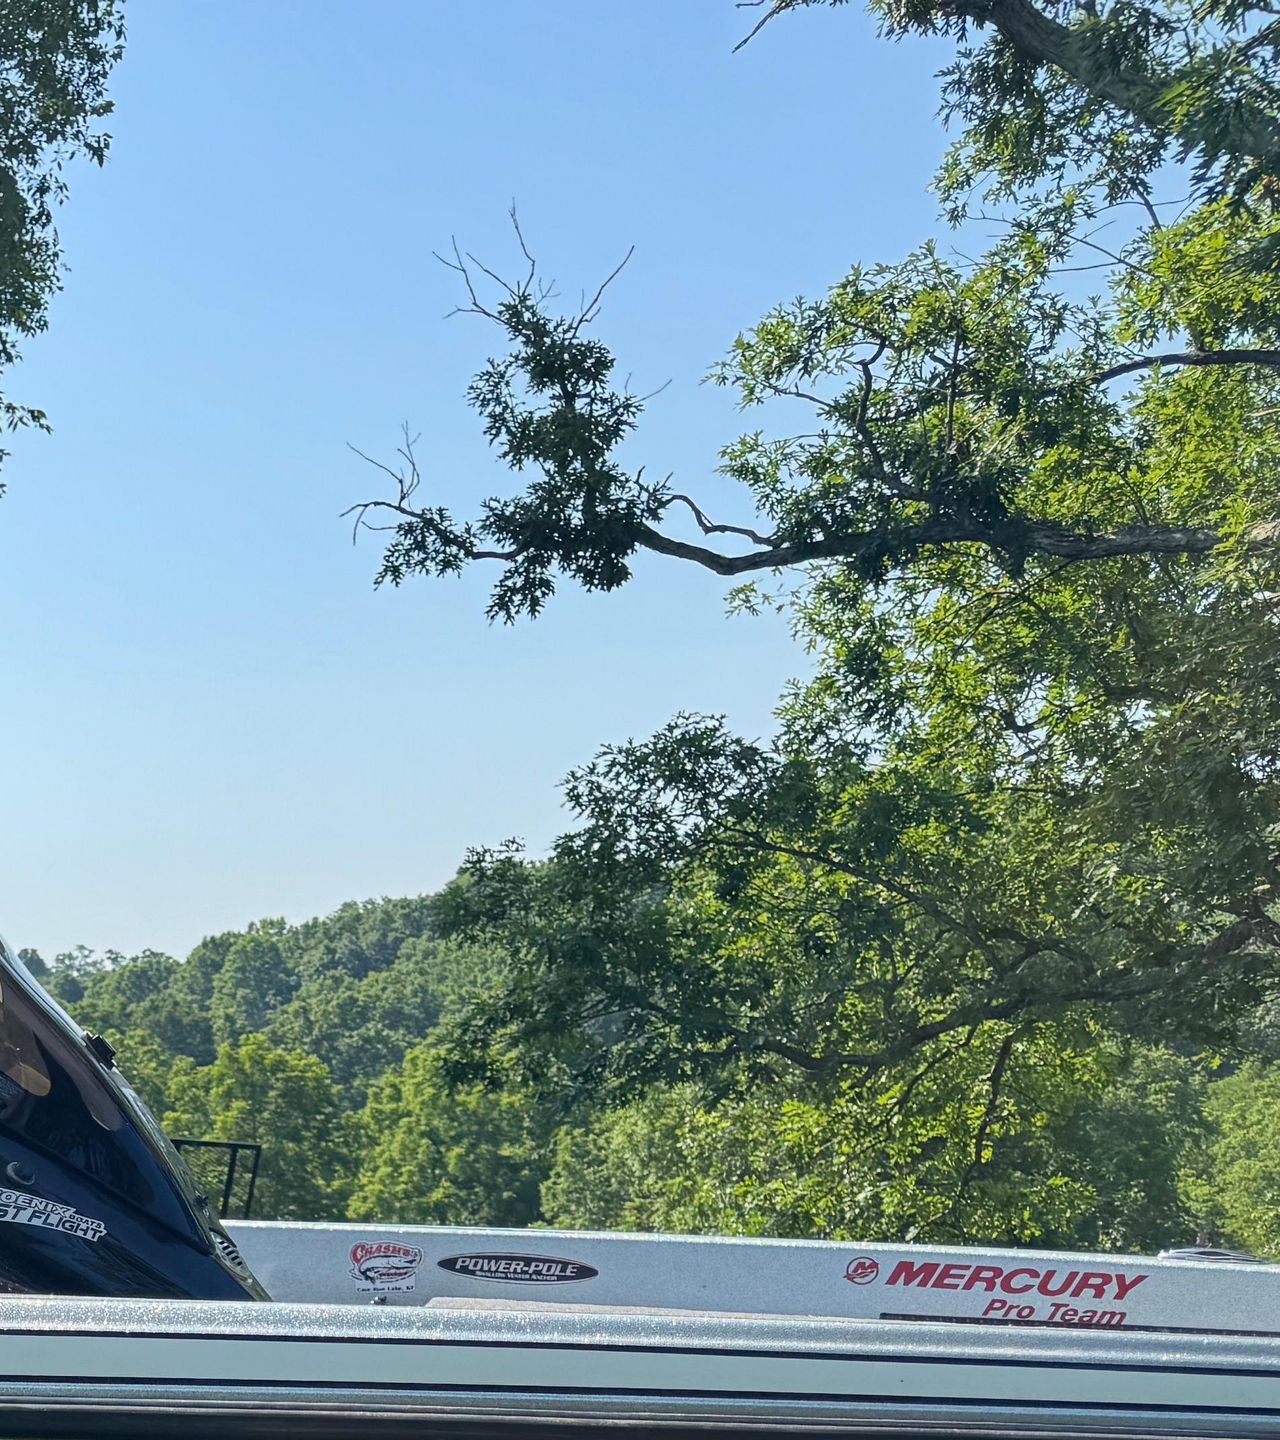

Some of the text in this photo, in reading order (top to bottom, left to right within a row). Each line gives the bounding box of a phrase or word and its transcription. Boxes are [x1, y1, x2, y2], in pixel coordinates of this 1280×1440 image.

[27, 1210, 105, 1240] FLIGHT
[68, 1214, 103, 1229] BOATS
[455, 1257, 580, 1276] POWER-POLE
[885, 1260, 1149, 1301] MERCURY
[981, 1298, 1128, 1327] Pro Team
